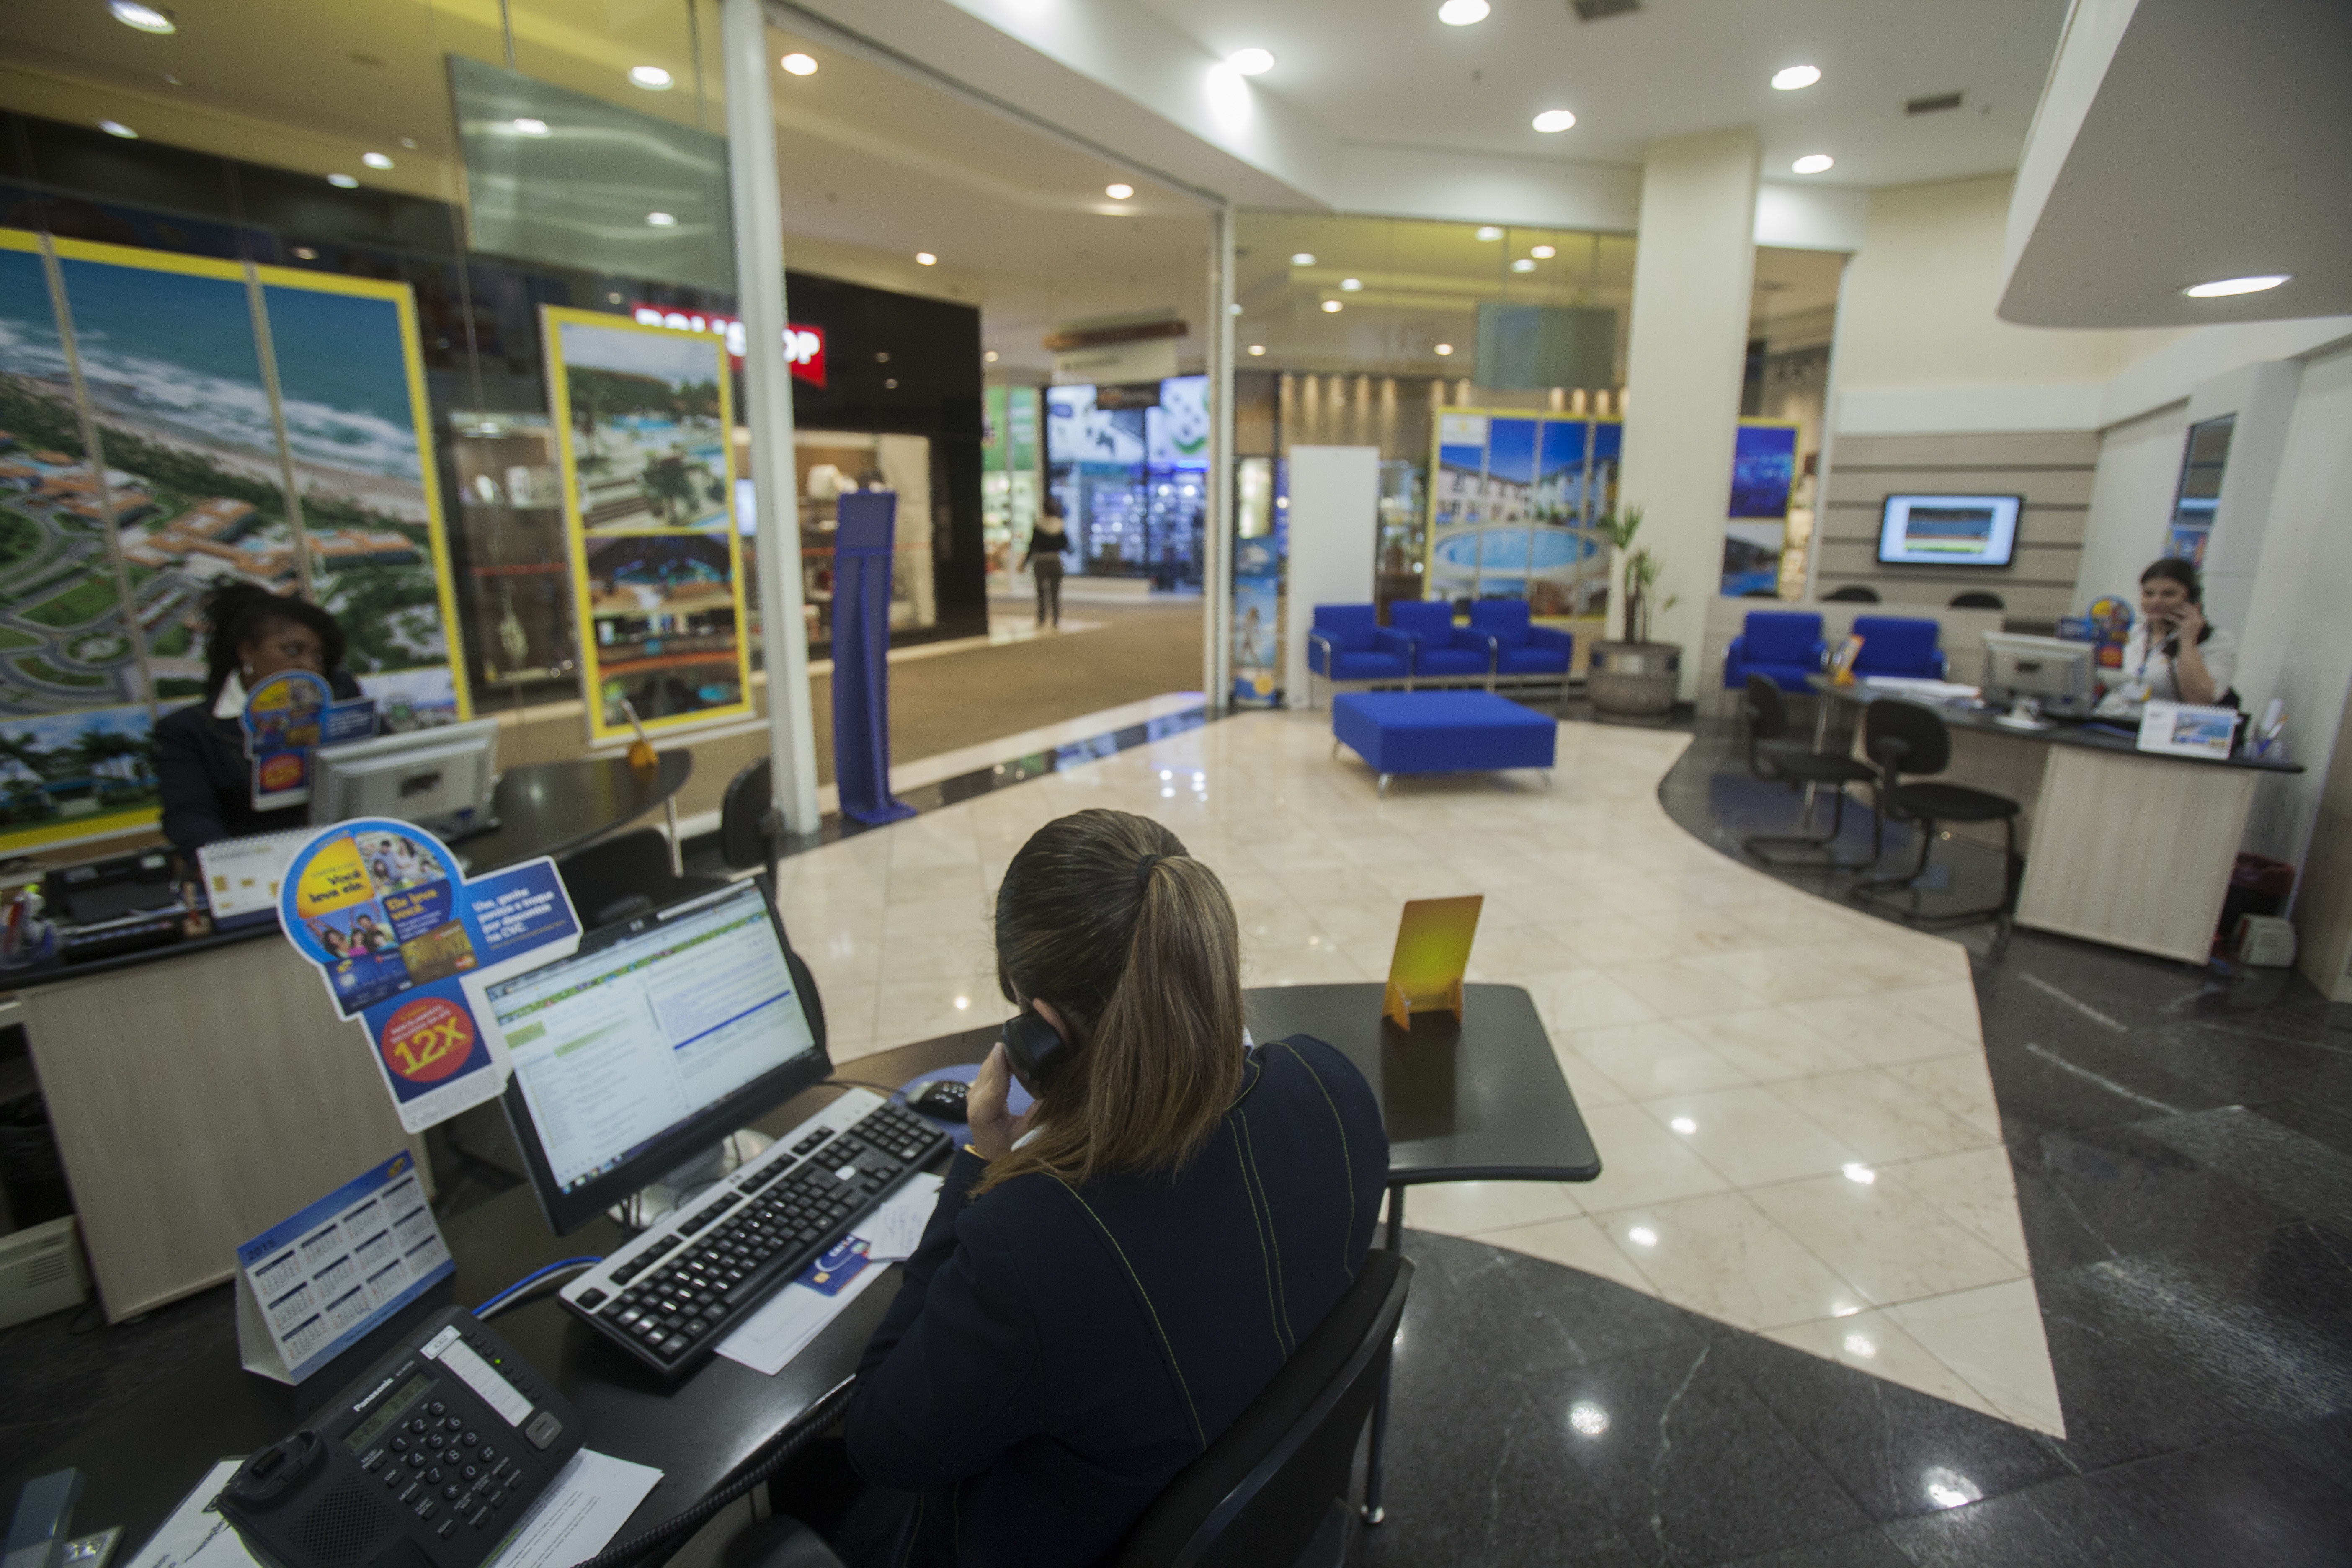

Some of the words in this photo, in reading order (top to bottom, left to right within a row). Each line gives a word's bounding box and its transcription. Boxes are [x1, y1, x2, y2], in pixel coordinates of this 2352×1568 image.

[328, 870, 361, 885] Você
[309, 890, 339, 903] leva
[342, 882, 366, 893] ele.
[387, 899, 407, 910] Ele
[408, 889, 438, 905] leva
[391, 903, 424, 920] você.
[514, 903, 524, 912] e
[393, 1016, 467, 1076] 12X
[247, 1238, 276, 1261] 2015
[353, 1378, 394, 1412] Panasonic
[433, 1402, 444, 1412] 3
[415, 1419, 426, 1429] 2
[450, 1418, 461, 1426] 6
[432, 1434, 442, 1444] 5
[467, 1432, 477, 1442] 9
[362, 1449, 383, 1469] PROGRAM
[414, 1453, 423, 1462] 4
[449, 1450, 459, 1460] 8
[430, 1467, 440, 1478] 7
[466, 1465, 476, 1475] 0
[399, 1482, 418, 1501] MESSAGE
